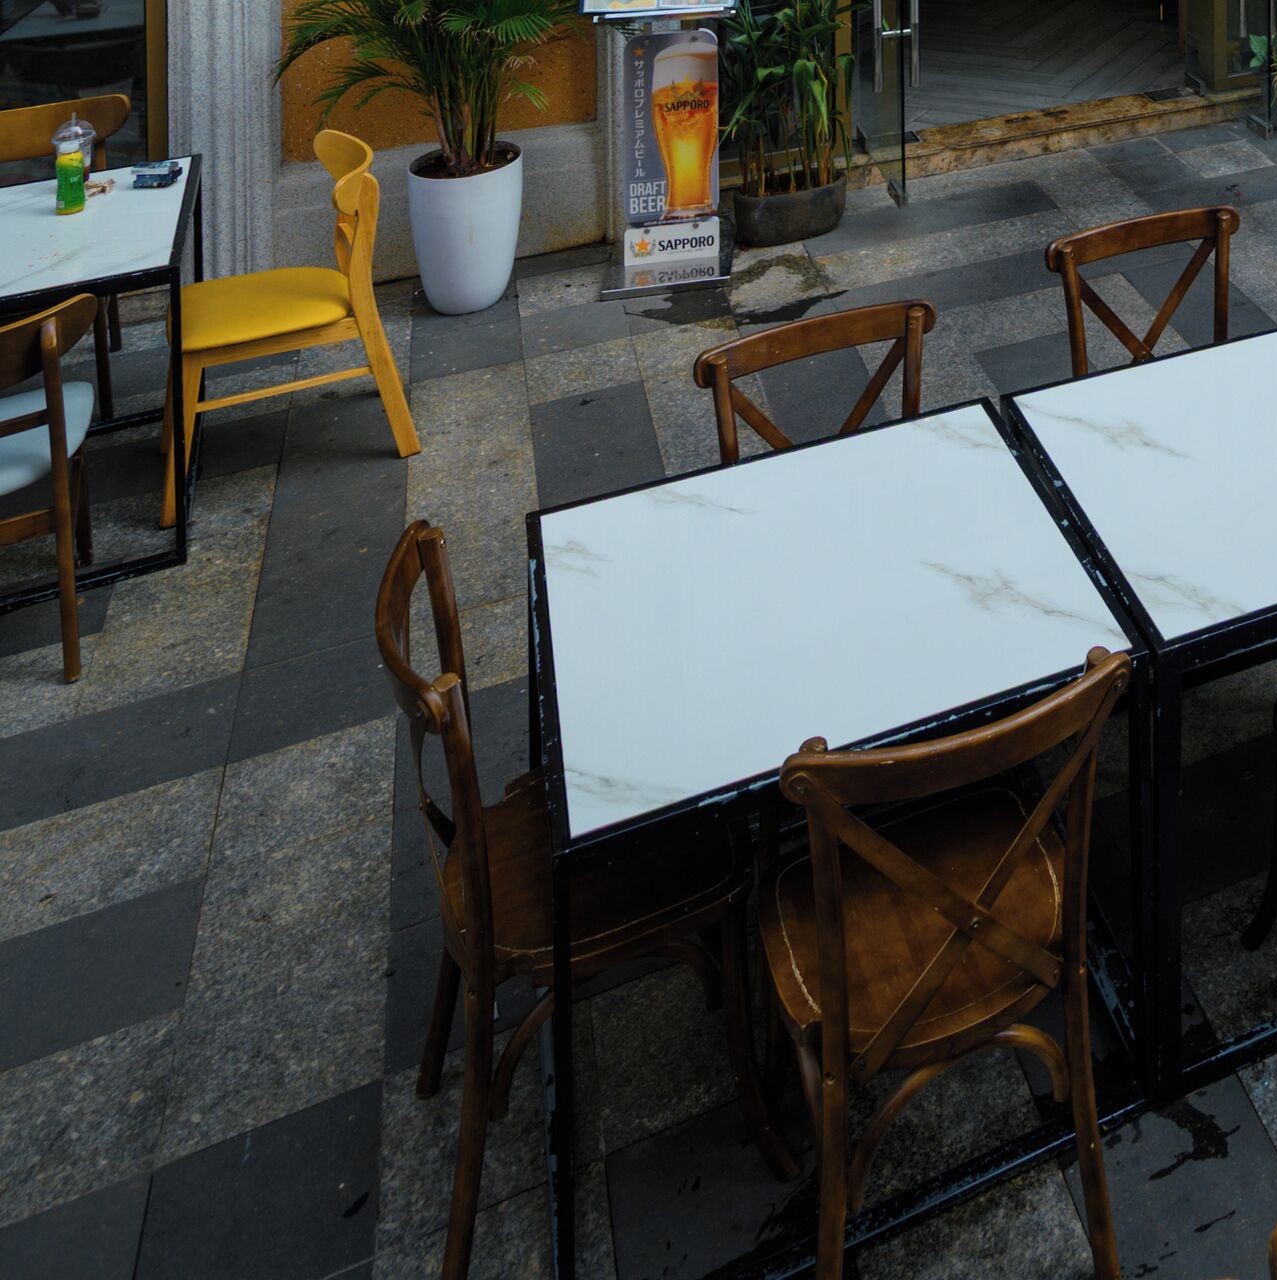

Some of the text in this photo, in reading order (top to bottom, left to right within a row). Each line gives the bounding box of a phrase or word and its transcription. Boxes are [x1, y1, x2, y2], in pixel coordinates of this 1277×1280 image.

[664, 99, 710, 113] SAPPORO
[629, 181, 667, 197] DRAFT
[629, 196, 666, 215] BEER
[658, 234, 715, 252] SAPPORO
